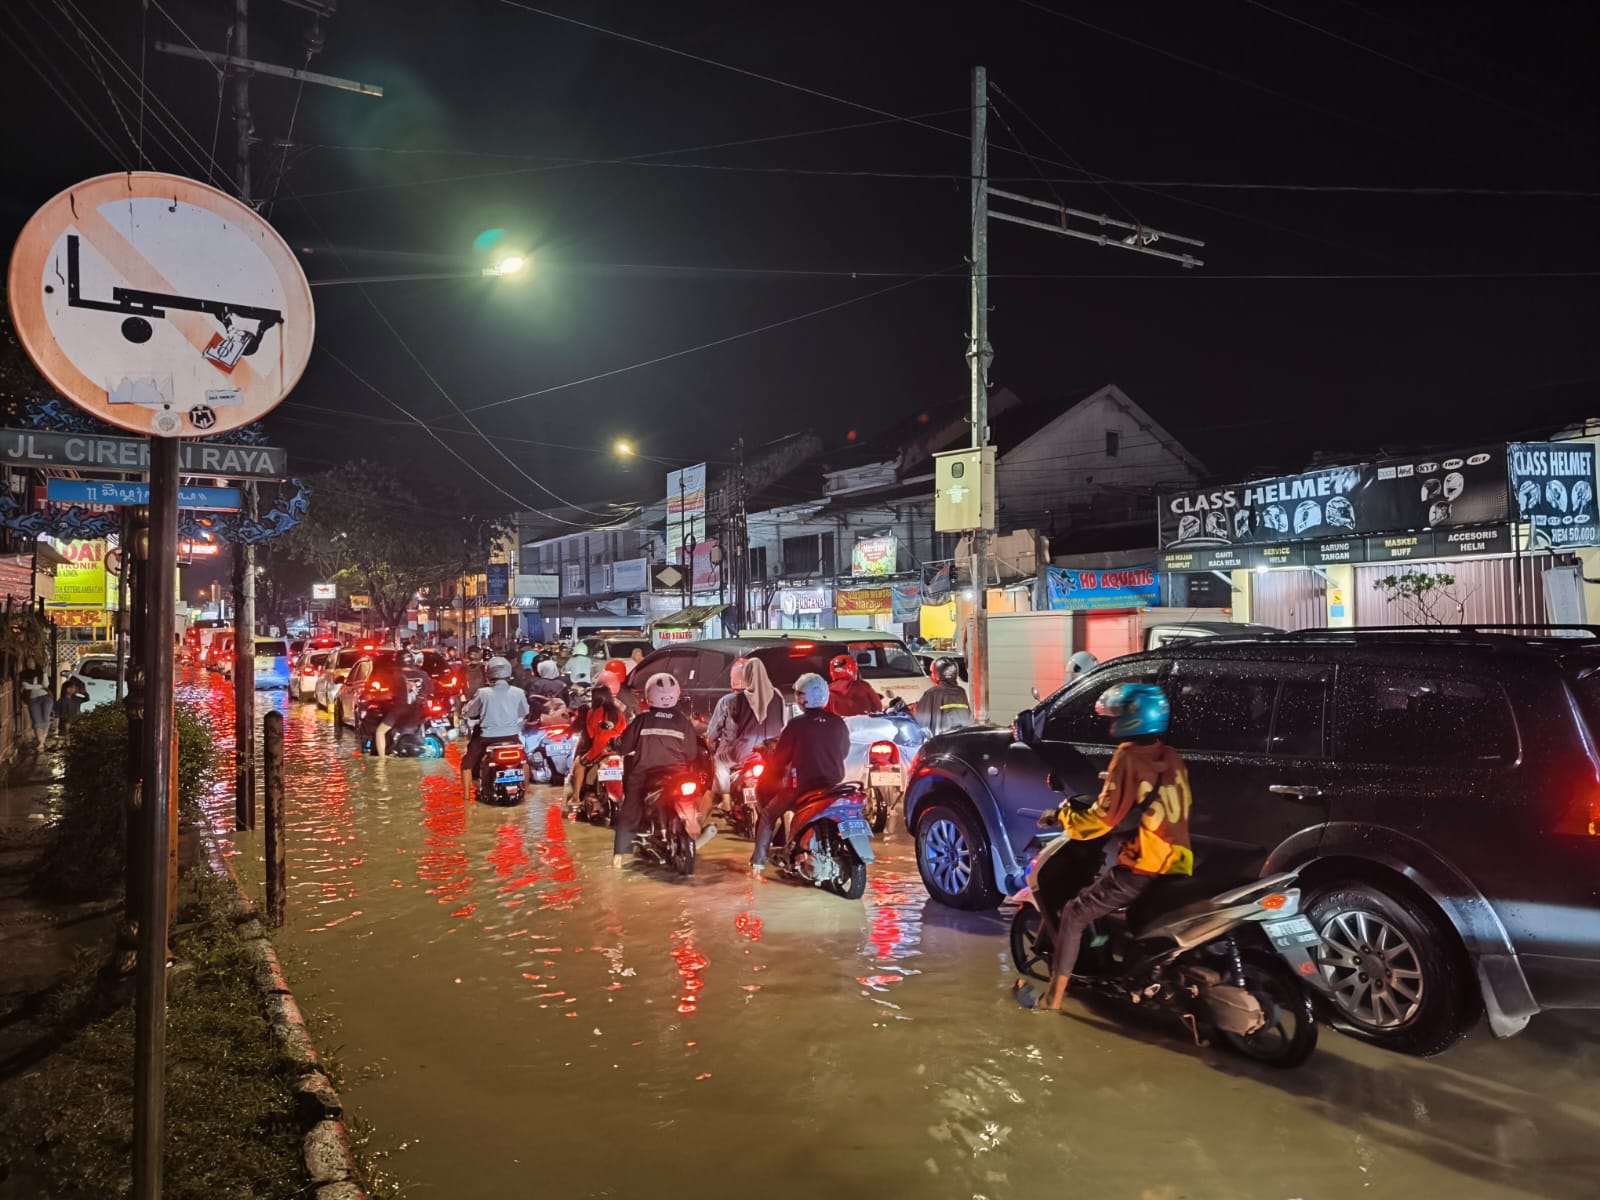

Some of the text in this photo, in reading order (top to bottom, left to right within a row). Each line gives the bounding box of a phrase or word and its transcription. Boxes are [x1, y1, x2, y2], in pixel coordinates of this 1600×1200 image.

[8, 435, 275, 474] JL. CIREI RAYA
[1513, 451, 1592, 477] CLASS HELMET
[1170, 476, 1345, 514] CLASS HELMET
[1448, 530, 1498, 542] ACCESORIS
[1320, 543, 1349, 552] SARUNG
[1384, 537, 1417, 548] MASKER
[1460, 542, 1485, 552] HELM
[1263, 547, 1290, 555] SERVICE
[1320, 552, 1350, 561] TANGAN
[1391, 547, 1412, 557] BUFF
[1101, 569, 1154, 590] AQUATIC
